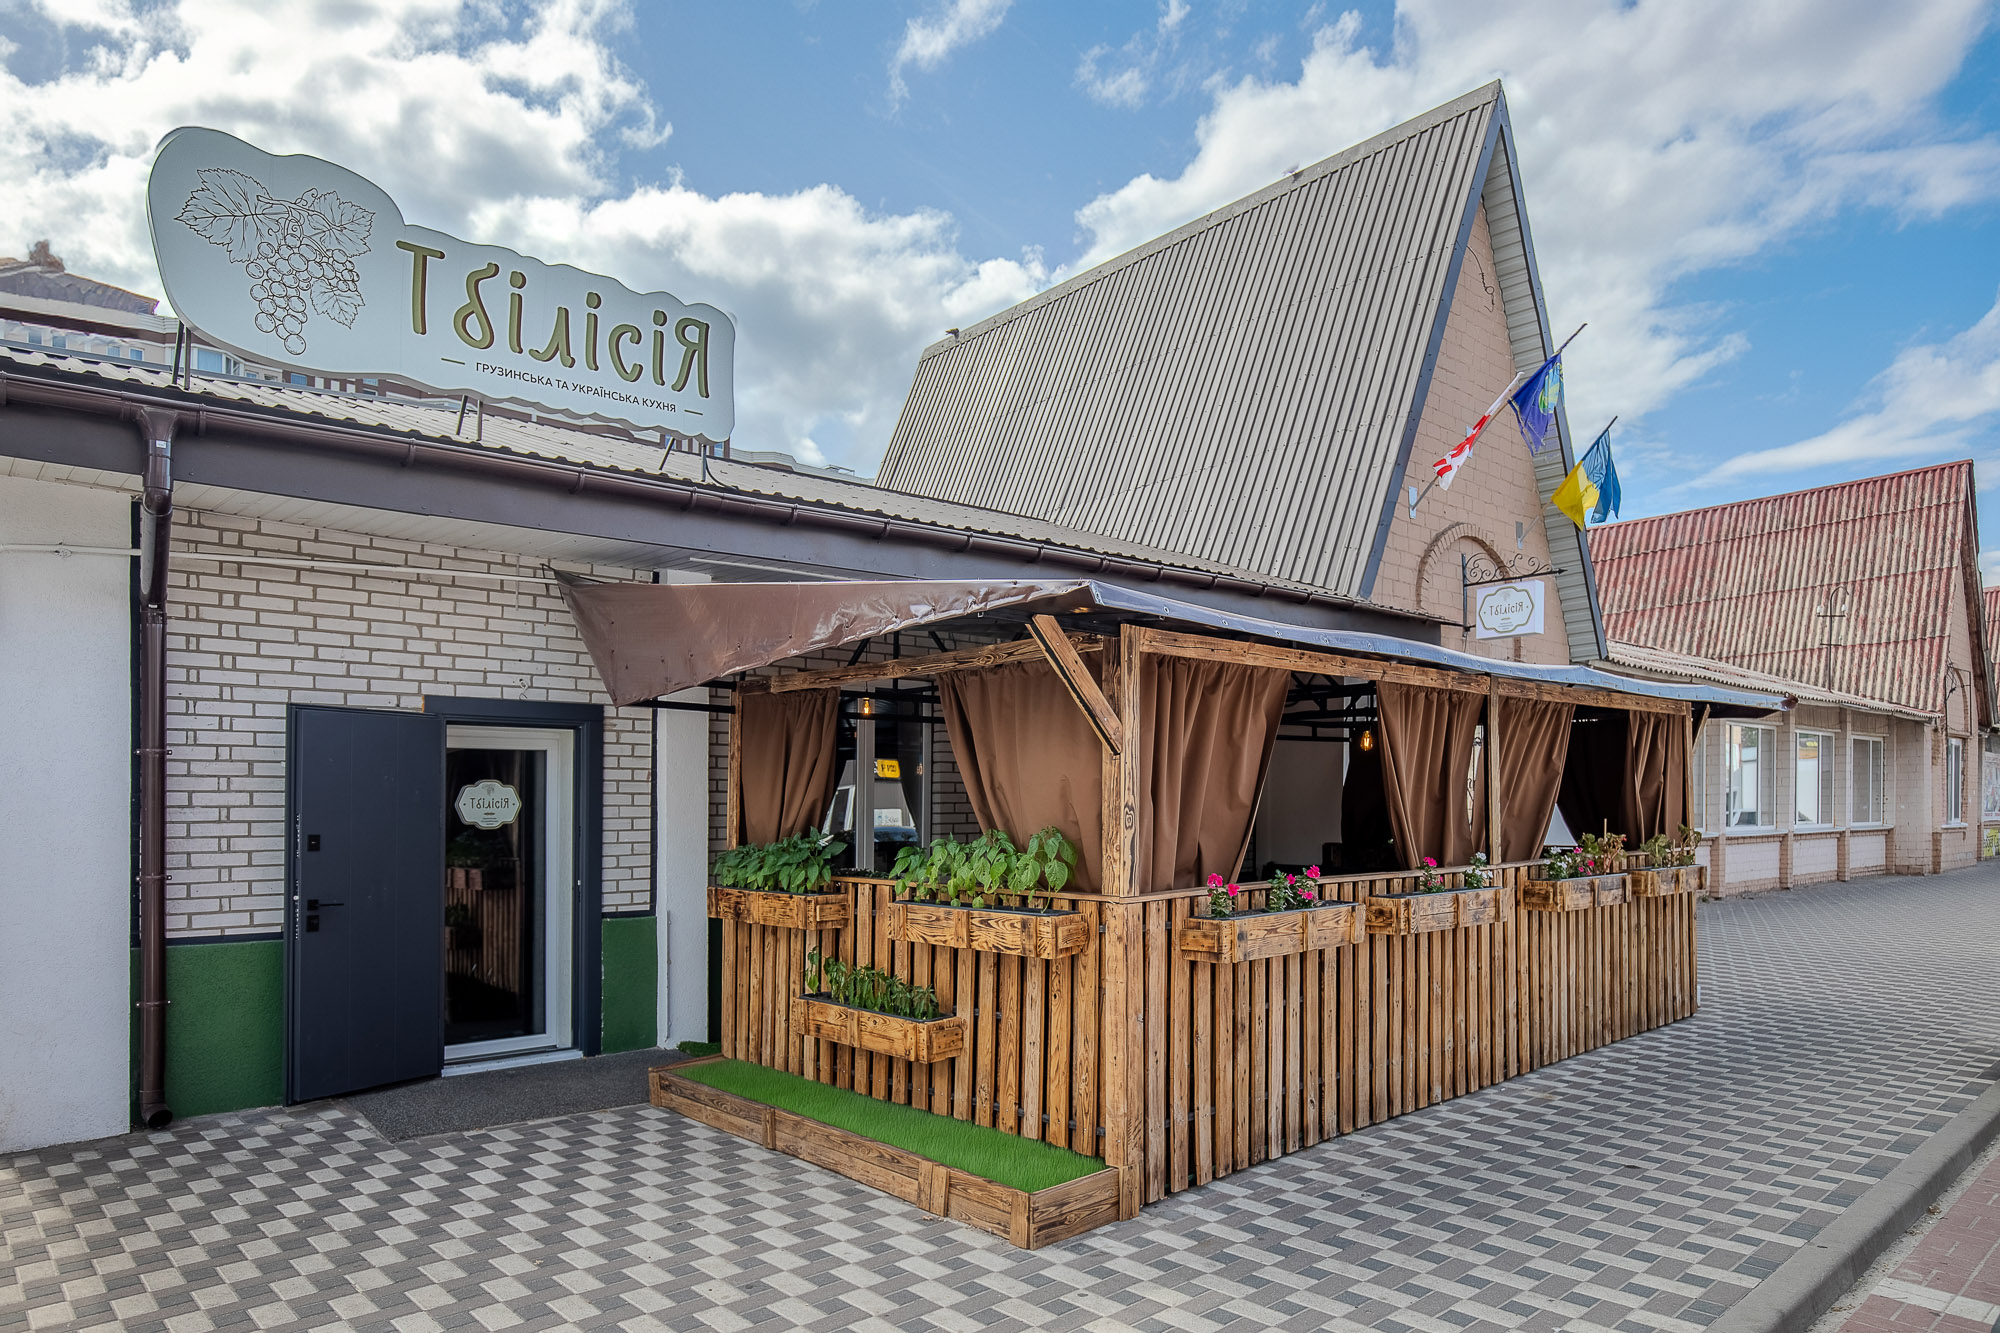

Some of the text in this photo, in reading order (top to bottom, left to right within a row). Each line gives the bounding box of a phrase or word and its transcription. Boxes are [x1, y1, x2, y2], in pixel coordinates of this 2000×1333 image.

[476, 362, 676, 413] ГРУЗИНСЬКА ТА УКРАЇНСЬКА КУХНЯ
